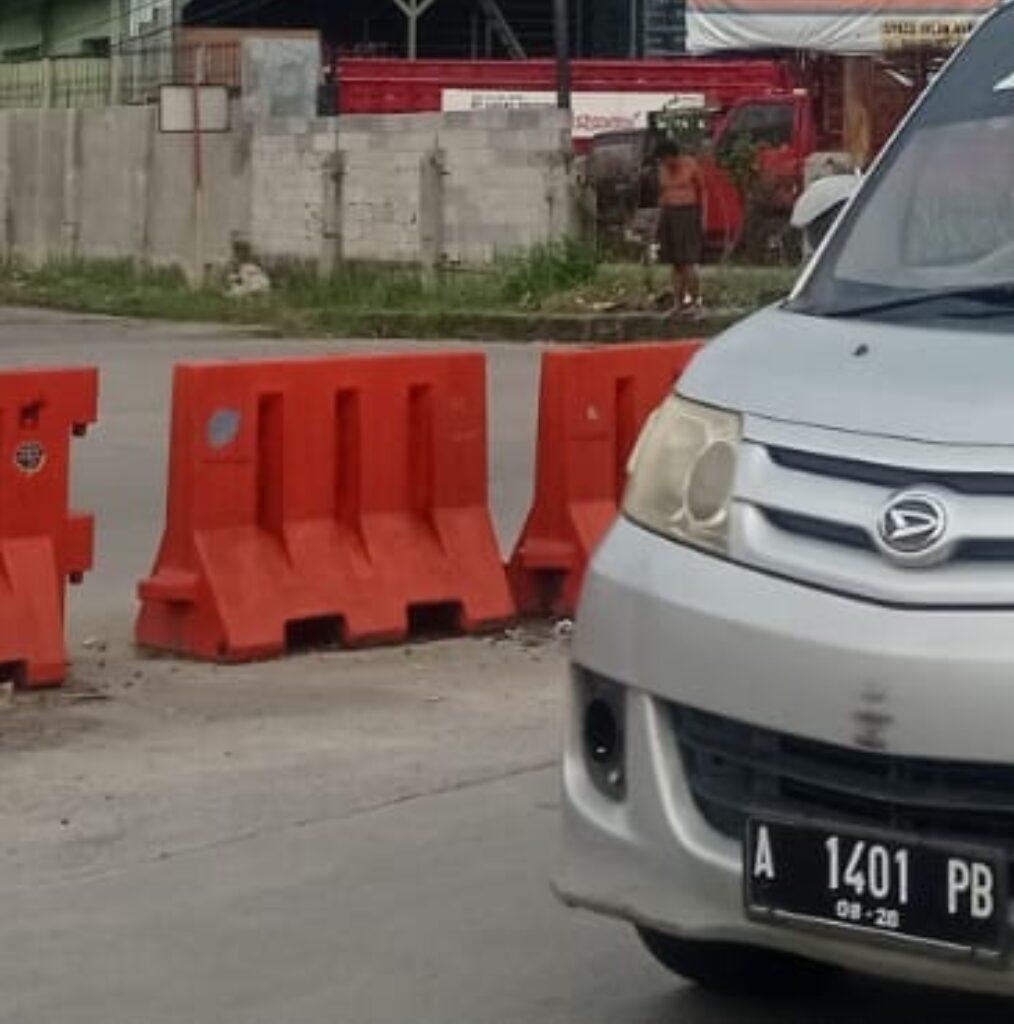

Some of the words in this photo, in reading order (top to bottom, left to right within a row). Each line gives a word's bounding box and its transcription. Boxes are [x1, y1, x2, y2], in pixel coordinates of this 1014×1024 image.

[753, 824, 774, 879] A
[825, 835, 909, 905] 1401
[947, 857, 995, 919] PB
